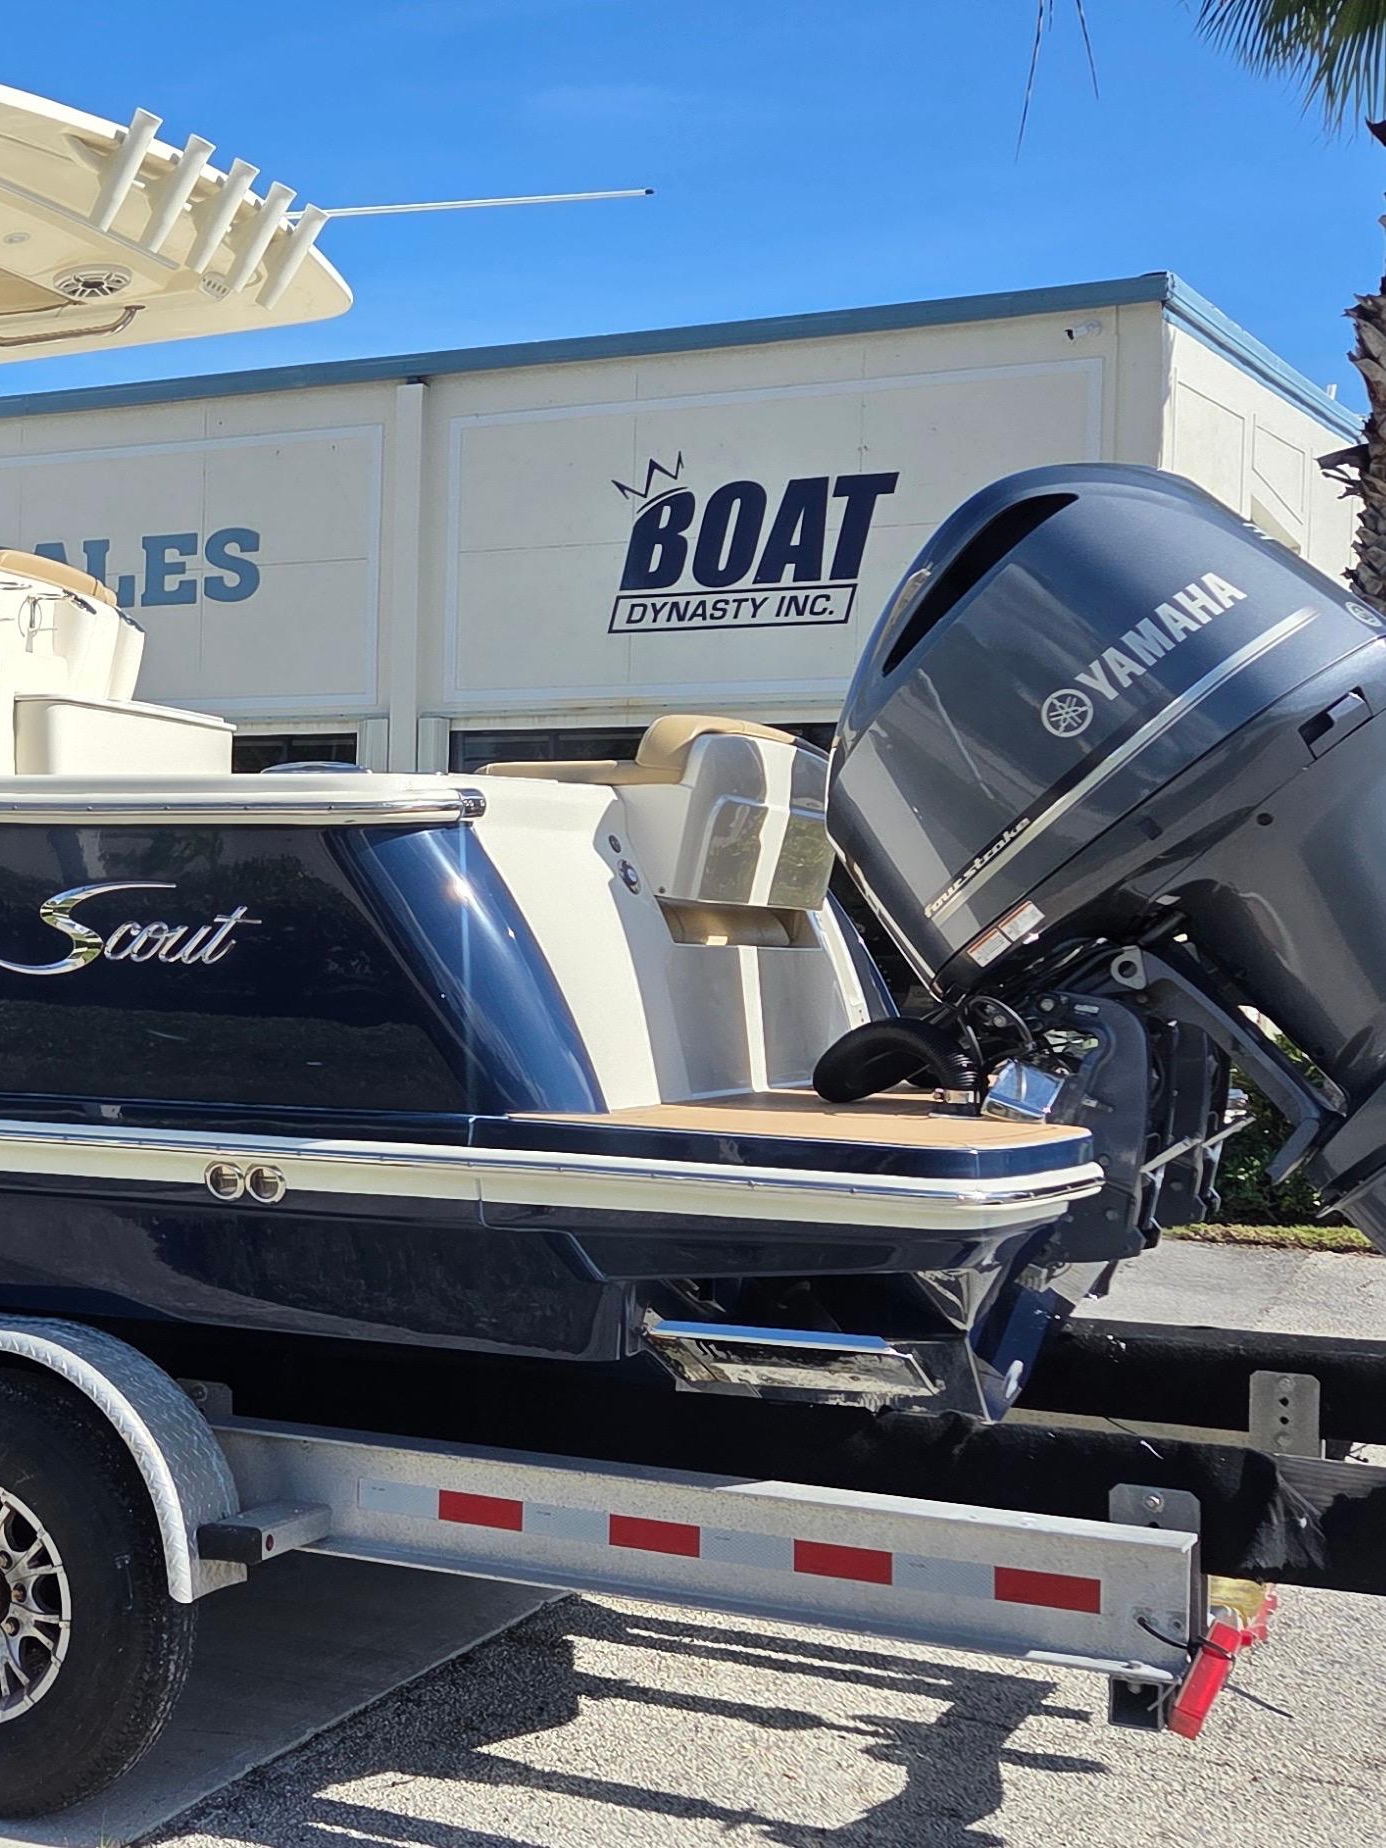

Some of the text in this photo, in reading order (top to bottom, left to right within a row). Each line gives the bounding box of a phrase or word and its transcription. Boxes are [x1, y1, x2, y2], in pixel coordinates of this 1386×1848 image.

[619, 472, 900, 591] BOAT
[625, 593, 835, 625] DYNASTY INC.
[1074, 572, 1248, 701] YAMAHA
[924, 817, 1032, 919] fourstroke
